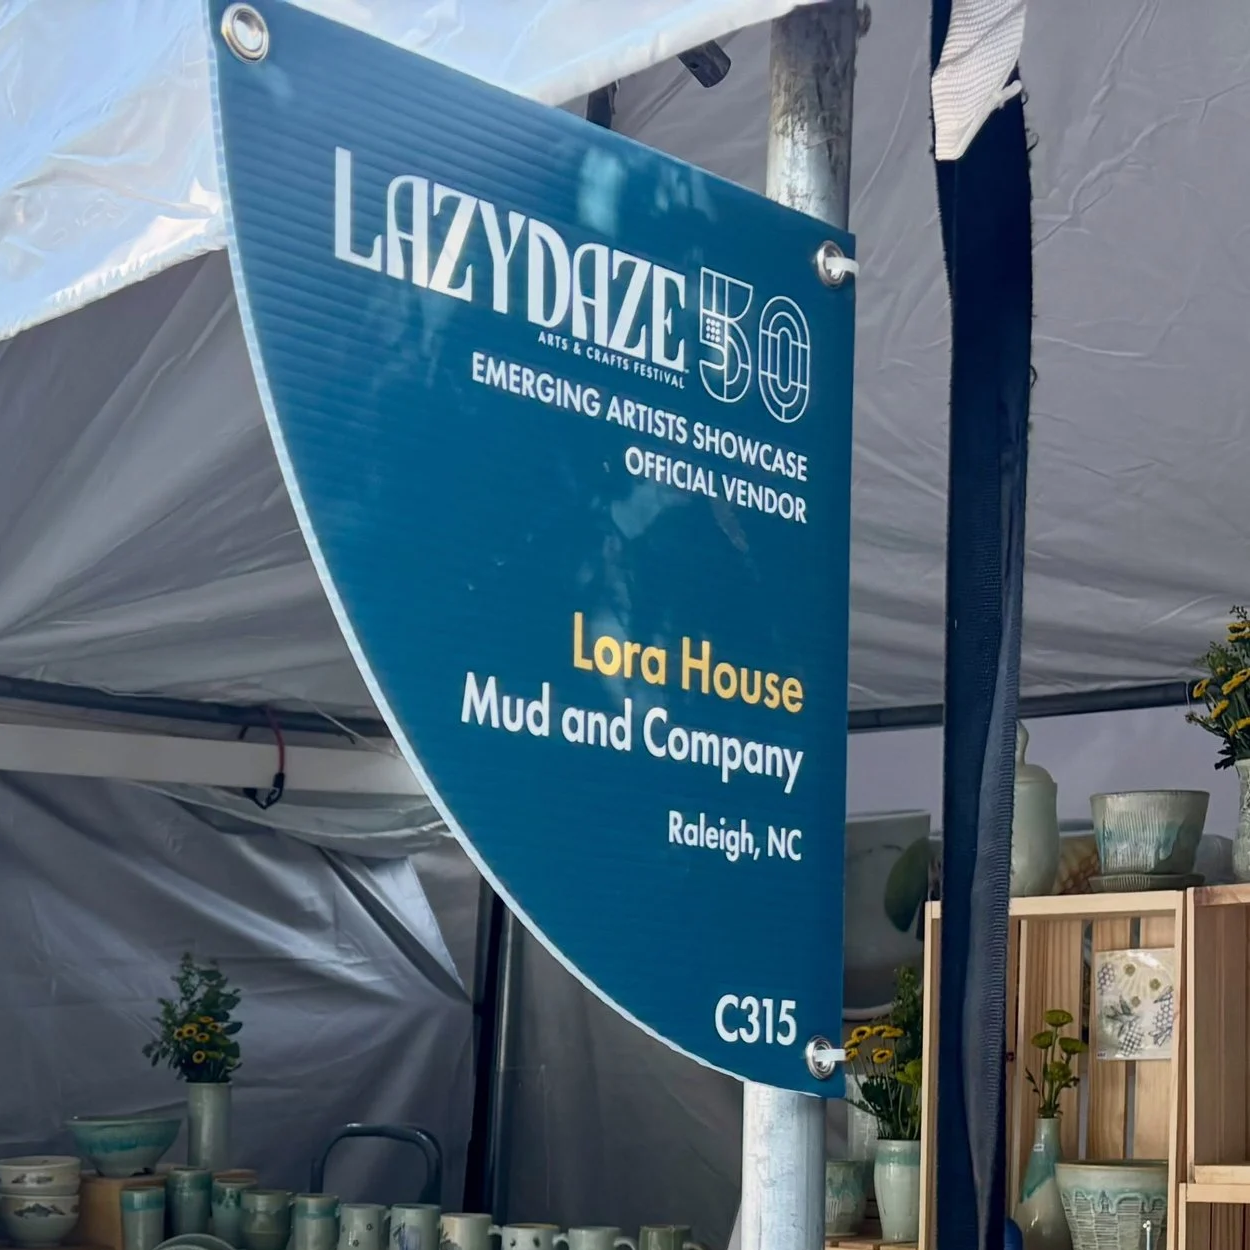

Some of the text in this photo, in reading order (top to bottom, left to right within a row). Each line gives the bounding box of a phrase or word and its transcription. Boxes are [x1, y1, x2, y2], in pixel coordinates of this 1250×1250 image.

[537, 330, 686, 390] ARTS & CRAFTS FESTIVAL
[699, 266, 810, 423] 50
[472, 352, 808, 482] EMERGING ARTISTS SHOWCASE
[625, 445, 808, 524] OFFICIAL VENDOR
[572, 611, 804, 714] Lora House
[460, 671, 804, 794] Mud and Company
[668, 810, 802, 862] Raleigh, NC
[713, 994, 798, 1045] C315
